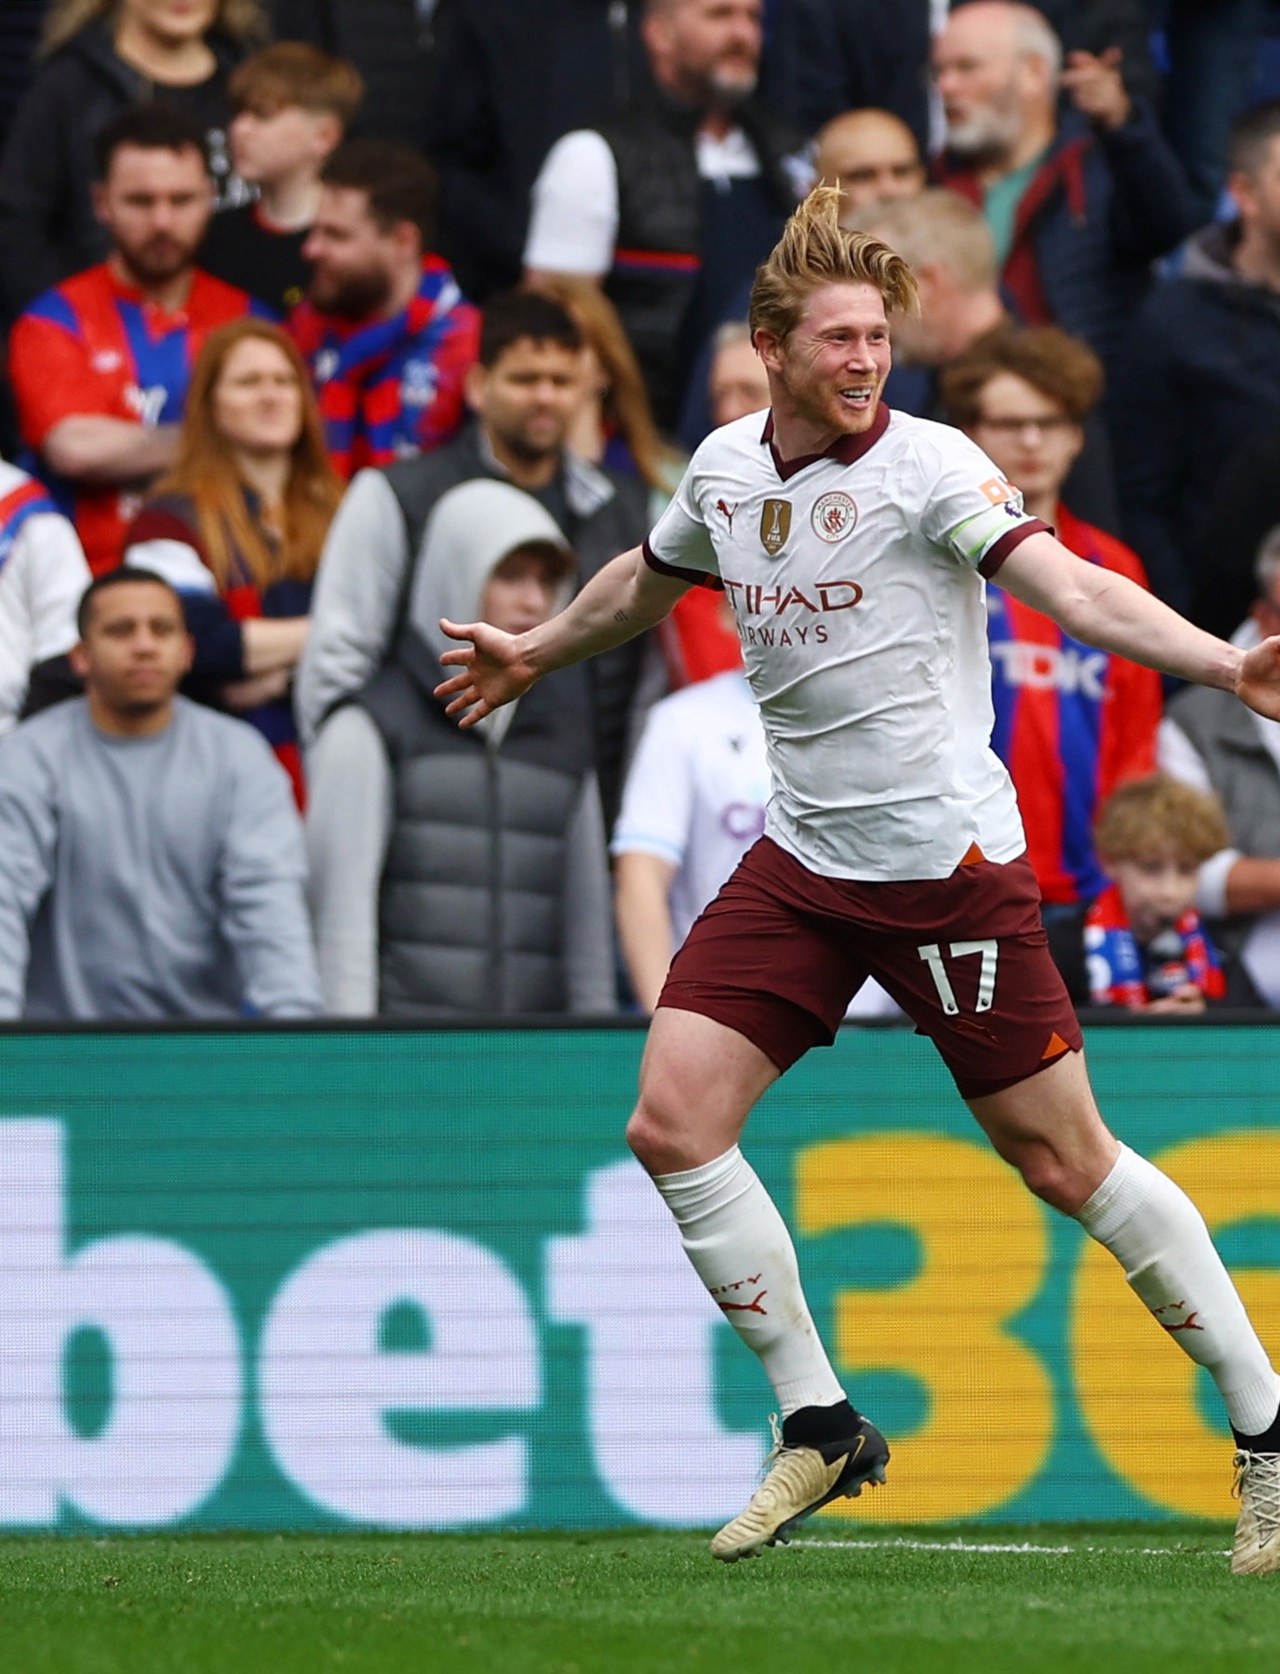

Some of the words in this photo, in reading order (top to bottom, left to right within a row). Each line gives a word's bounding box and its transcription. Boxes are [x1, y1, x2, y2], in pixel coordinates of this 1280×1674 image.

[817, 495, 853, 511] MANCHESTER
[767, 533, 780, 541] FIFA
[723, 580, 864, 615] TIHAD
[989, 640, 1108, 701] TDK
[917, 939, 998, 1015] 17
